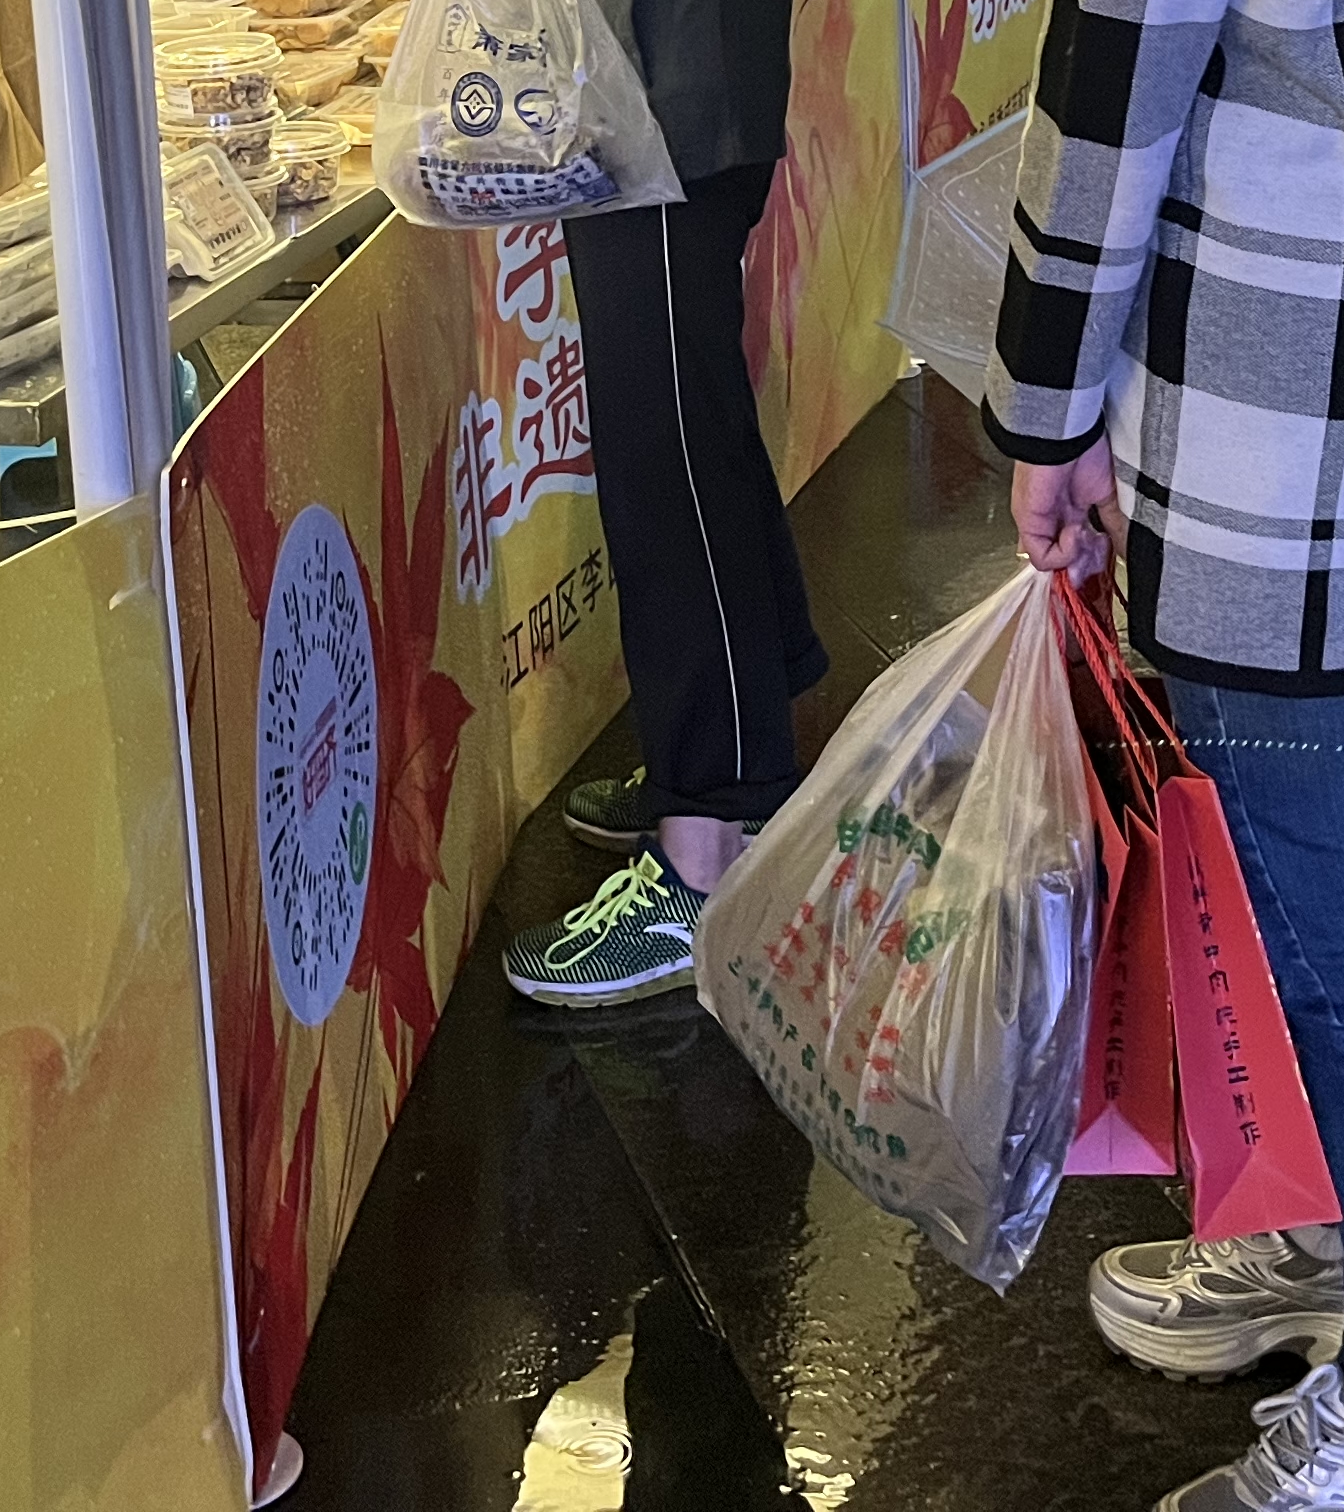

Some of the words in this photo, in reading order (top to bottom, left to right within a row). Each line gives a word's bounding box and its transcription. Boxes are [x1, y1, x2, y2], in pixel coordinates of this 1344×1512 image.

[459, 335, 594, 586] 非遗
[500, 546, 617, 692] 江阳区李
